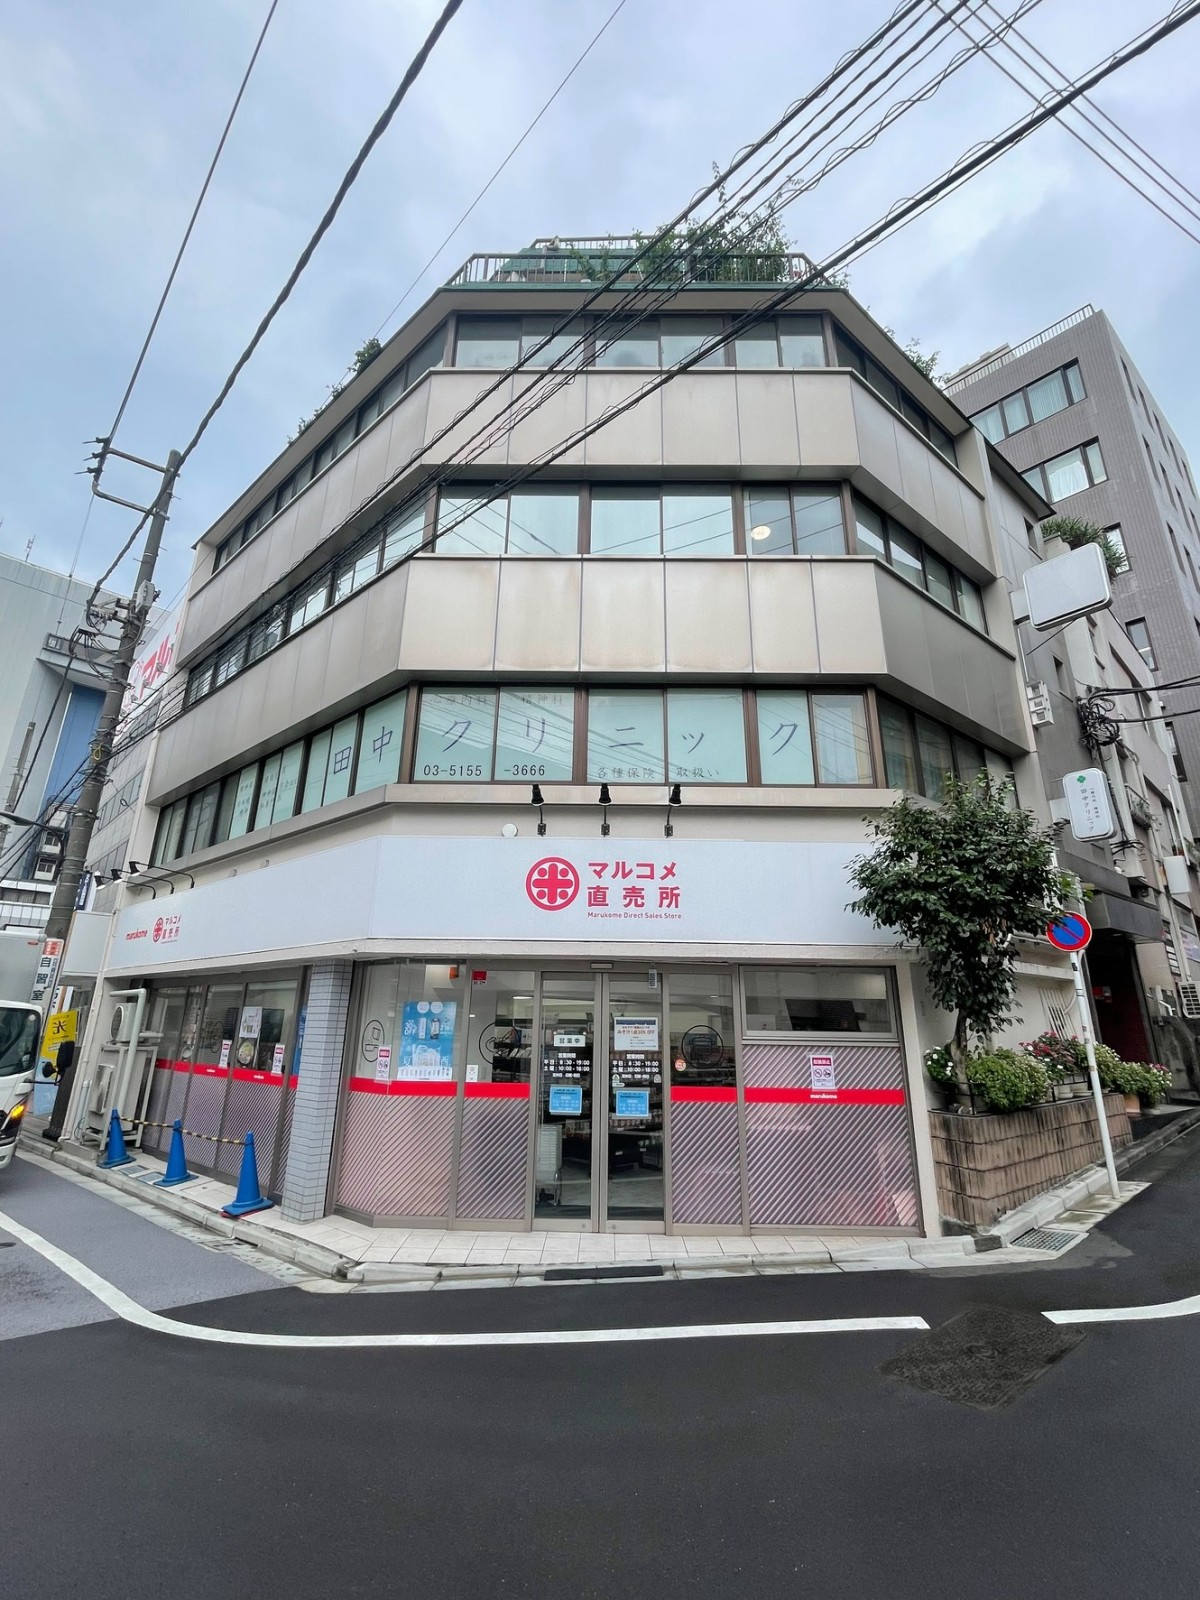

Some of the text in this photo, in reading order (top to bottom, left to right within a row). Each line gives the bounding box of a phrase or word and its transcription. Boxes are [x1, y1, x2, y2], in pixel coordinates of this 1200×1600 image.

[588, 861, 677, 881] マルコメ
[587, 885, 681, 909] 直売所
[587, 911, 622, 919] Marukome
[623, 911, 644, 919] Direct
[31, 956, 52, 1001] 自習室
